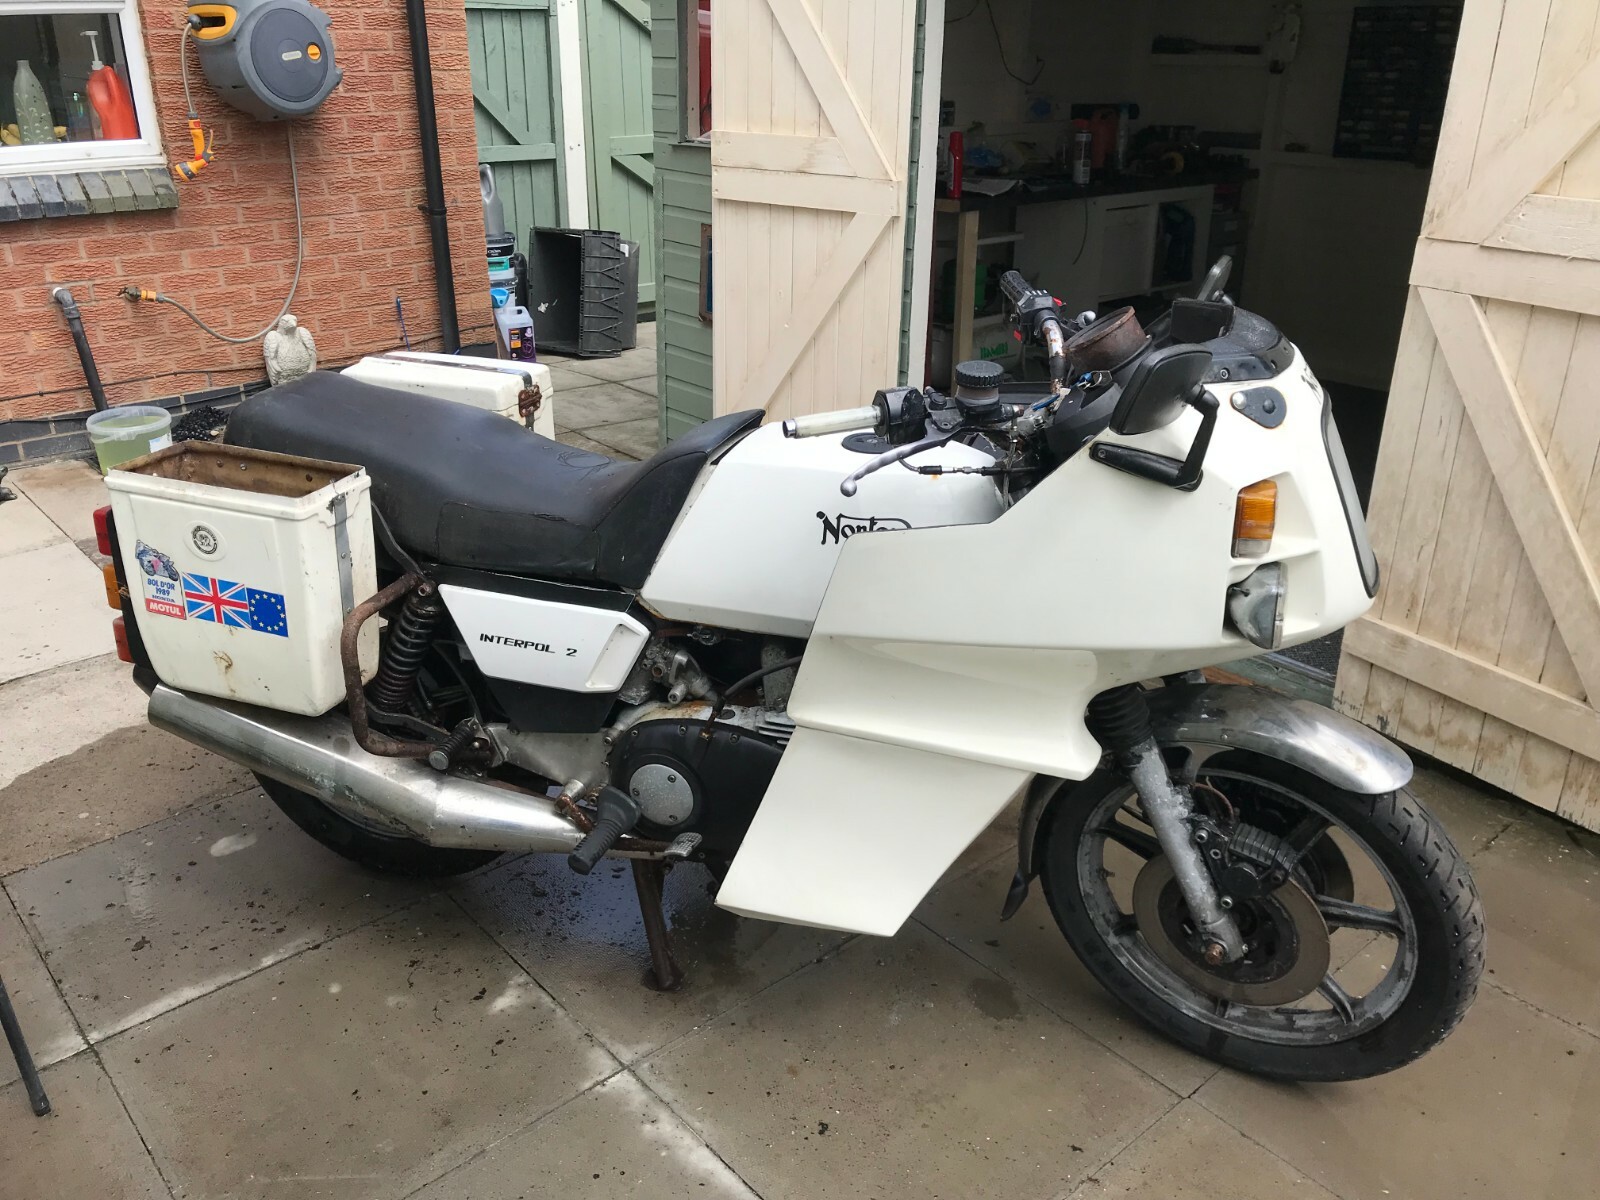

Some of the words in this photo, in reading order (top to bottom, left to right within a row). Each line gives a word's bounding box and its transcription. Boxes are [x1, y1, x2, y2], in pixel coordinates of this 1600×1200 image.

[816, 511, 912, 545] Nort
[147, 578, 159, 587] BOL
[160, 581, 175, 590] D'OR
[155, 588, 170, 596] 1989
[149, 601, 182, 616] MOTUL
[479, 633, 556, 654] INTERPOL
[565, 647, 578, 657] 2
